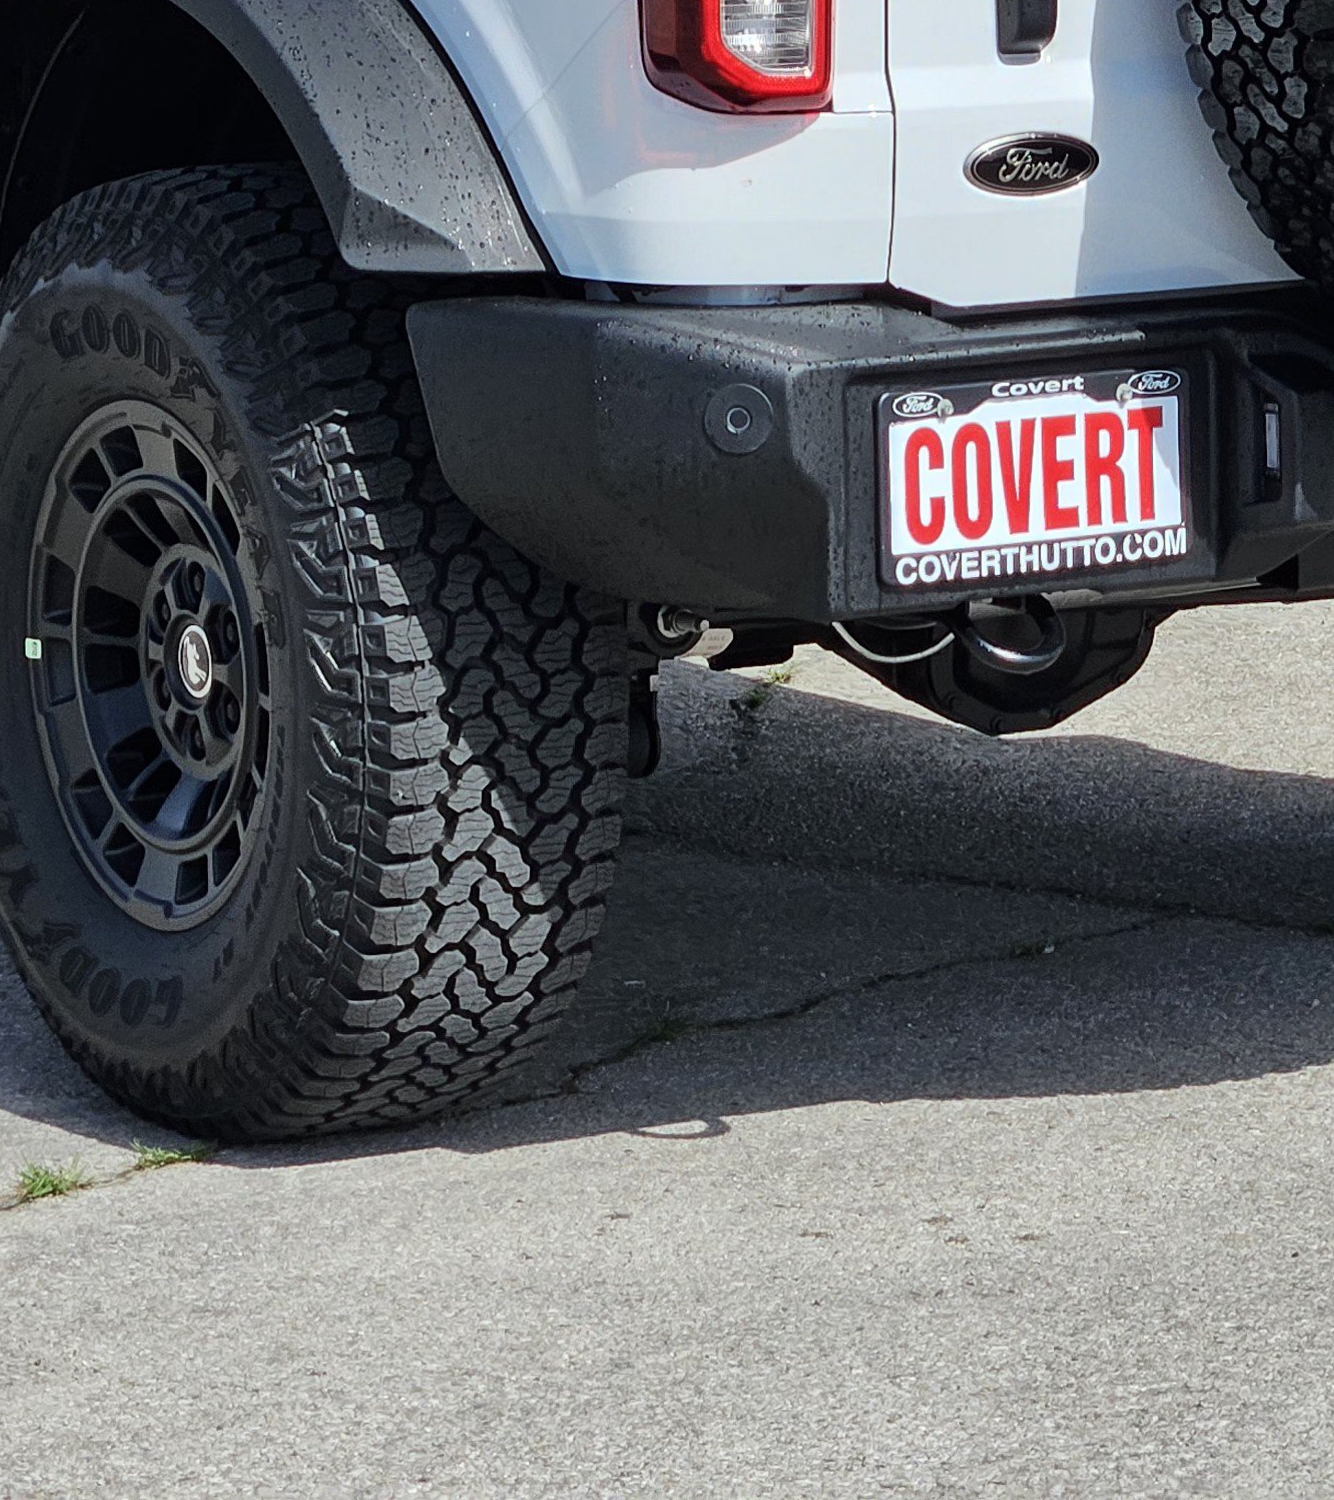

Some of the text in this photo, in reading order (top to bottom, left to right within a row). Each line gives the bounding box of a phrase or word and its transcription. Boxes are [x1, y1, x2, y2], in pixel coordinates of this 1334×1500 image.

[998, 147, 1069, 183] Ford
[901, 372, 1171, 414] Ford Covert Ford
[904, 405, 1164, 546] COVERT
[894, 527, 1188, 587] COVERTHUTTO.COM
